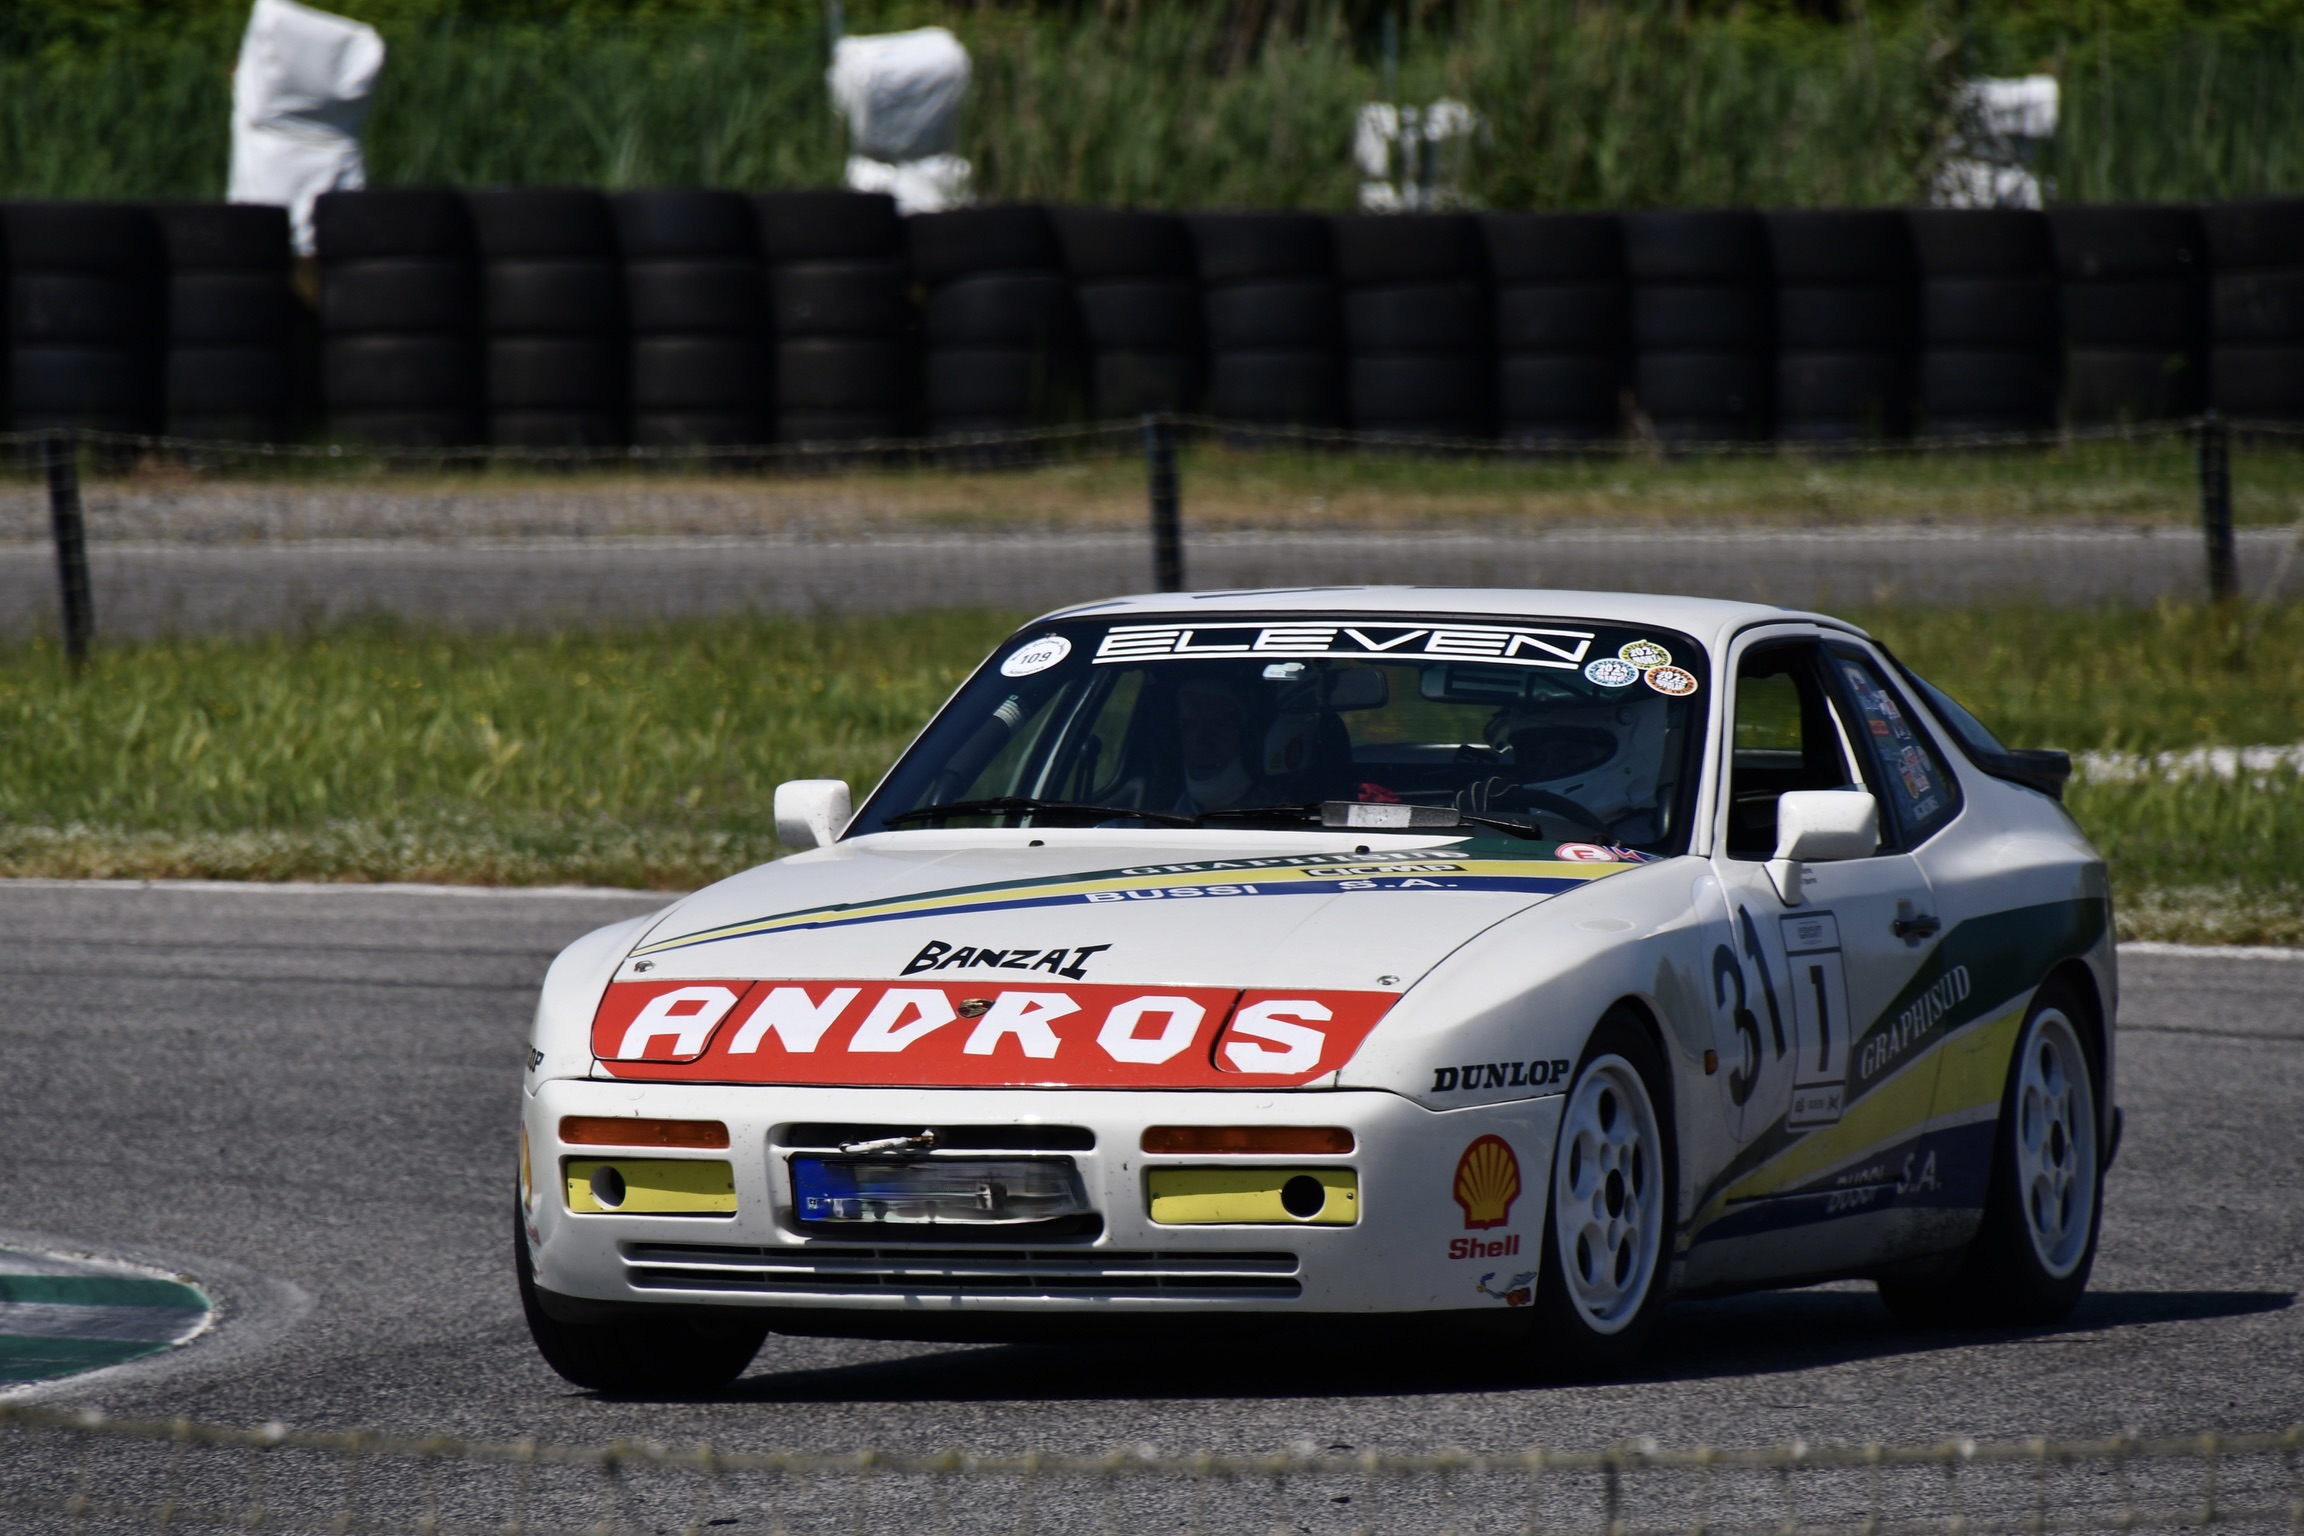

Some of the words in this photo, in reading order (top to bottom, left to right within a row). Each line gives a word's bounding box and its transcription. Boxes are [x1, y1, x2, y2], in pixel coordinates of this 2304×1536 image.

[1020, 651, 1053, 665] 109
[1095, 628, 1592, 663] ELEVEN
[1121, 851, 1471, 875] GRAPHISUD
[1084, 884, 1260, 904] BUSSI
[1337, 878, 1459, 891] S.A.
[899, 939, 1114, 981] BANZAI
[1712, 903, 1787, 1107] 31
[1808, 964, 1831, 1073] 1
[1861, 965, 1970, 1079] GRAPHISUD
[616, 985, 1334, 1075] ANDROS
[1430, 1059, 1570, 1092] DUNLOP
[1447, 1234, 1521, 1260] Shell
